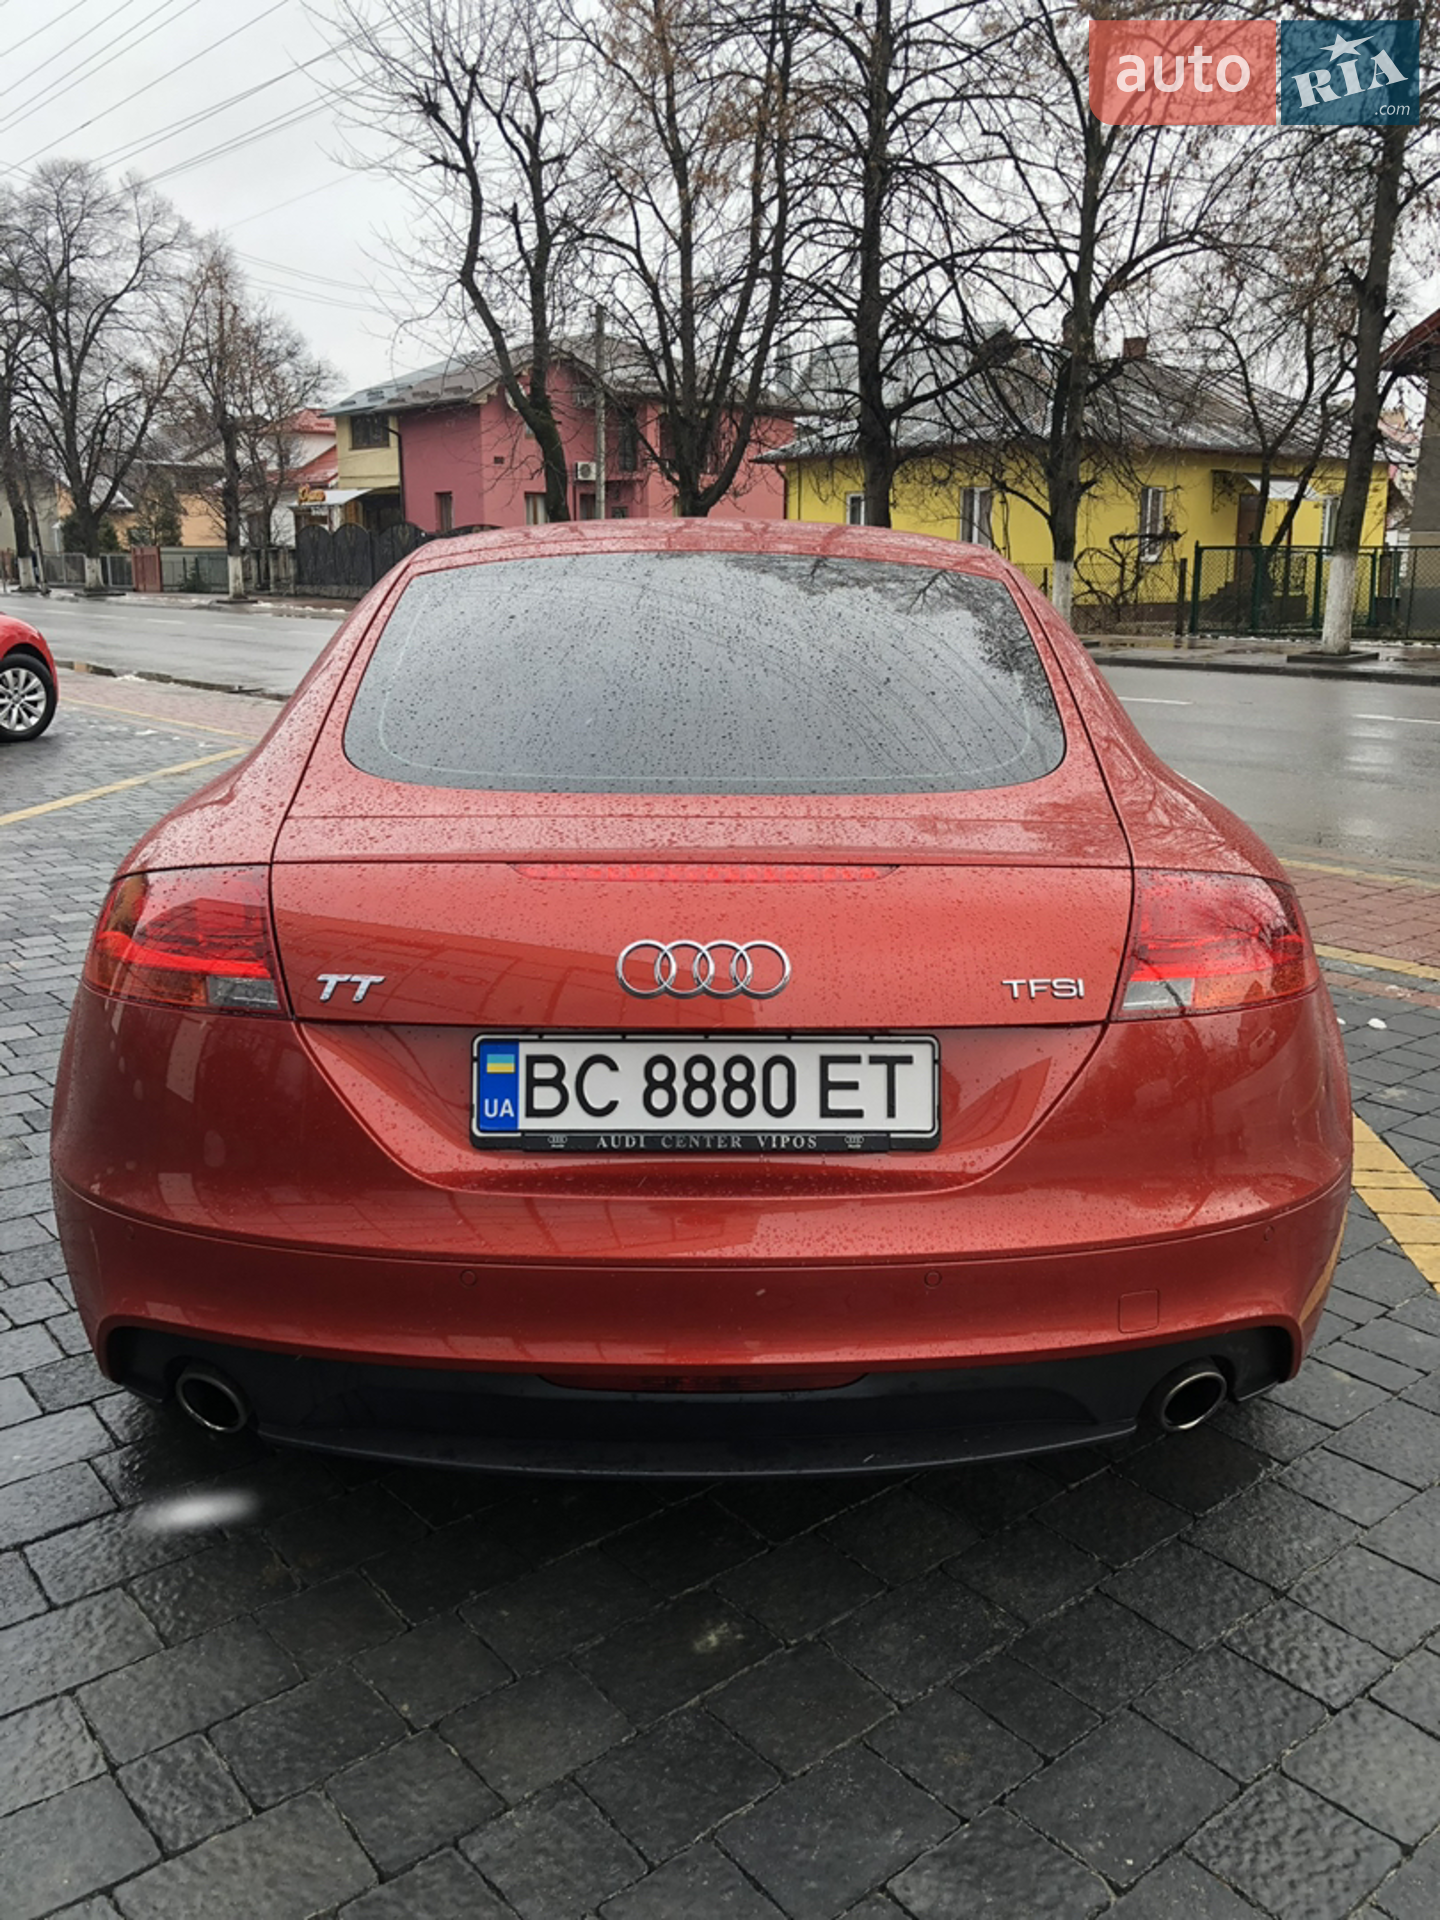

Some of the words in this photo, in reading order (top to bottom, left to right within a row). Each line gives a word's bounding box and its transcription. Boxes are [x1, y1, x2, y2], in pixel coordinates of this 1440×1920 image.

[317, 973, 386, 1003] TT
[1002, 978, 1085, 999] TFSI
[525, 1054, 619, 1118] BC
[643, 1054, 796, 1118] 8880
[819, 1055, 914, 1118] ET
[484, 1098, 514, 1118] UA
[596, 1135, 645, 1149] AUDI
[661, 1135, 742, 1149] CENTER
[756, 1135, 818, 1149] VIPOS
